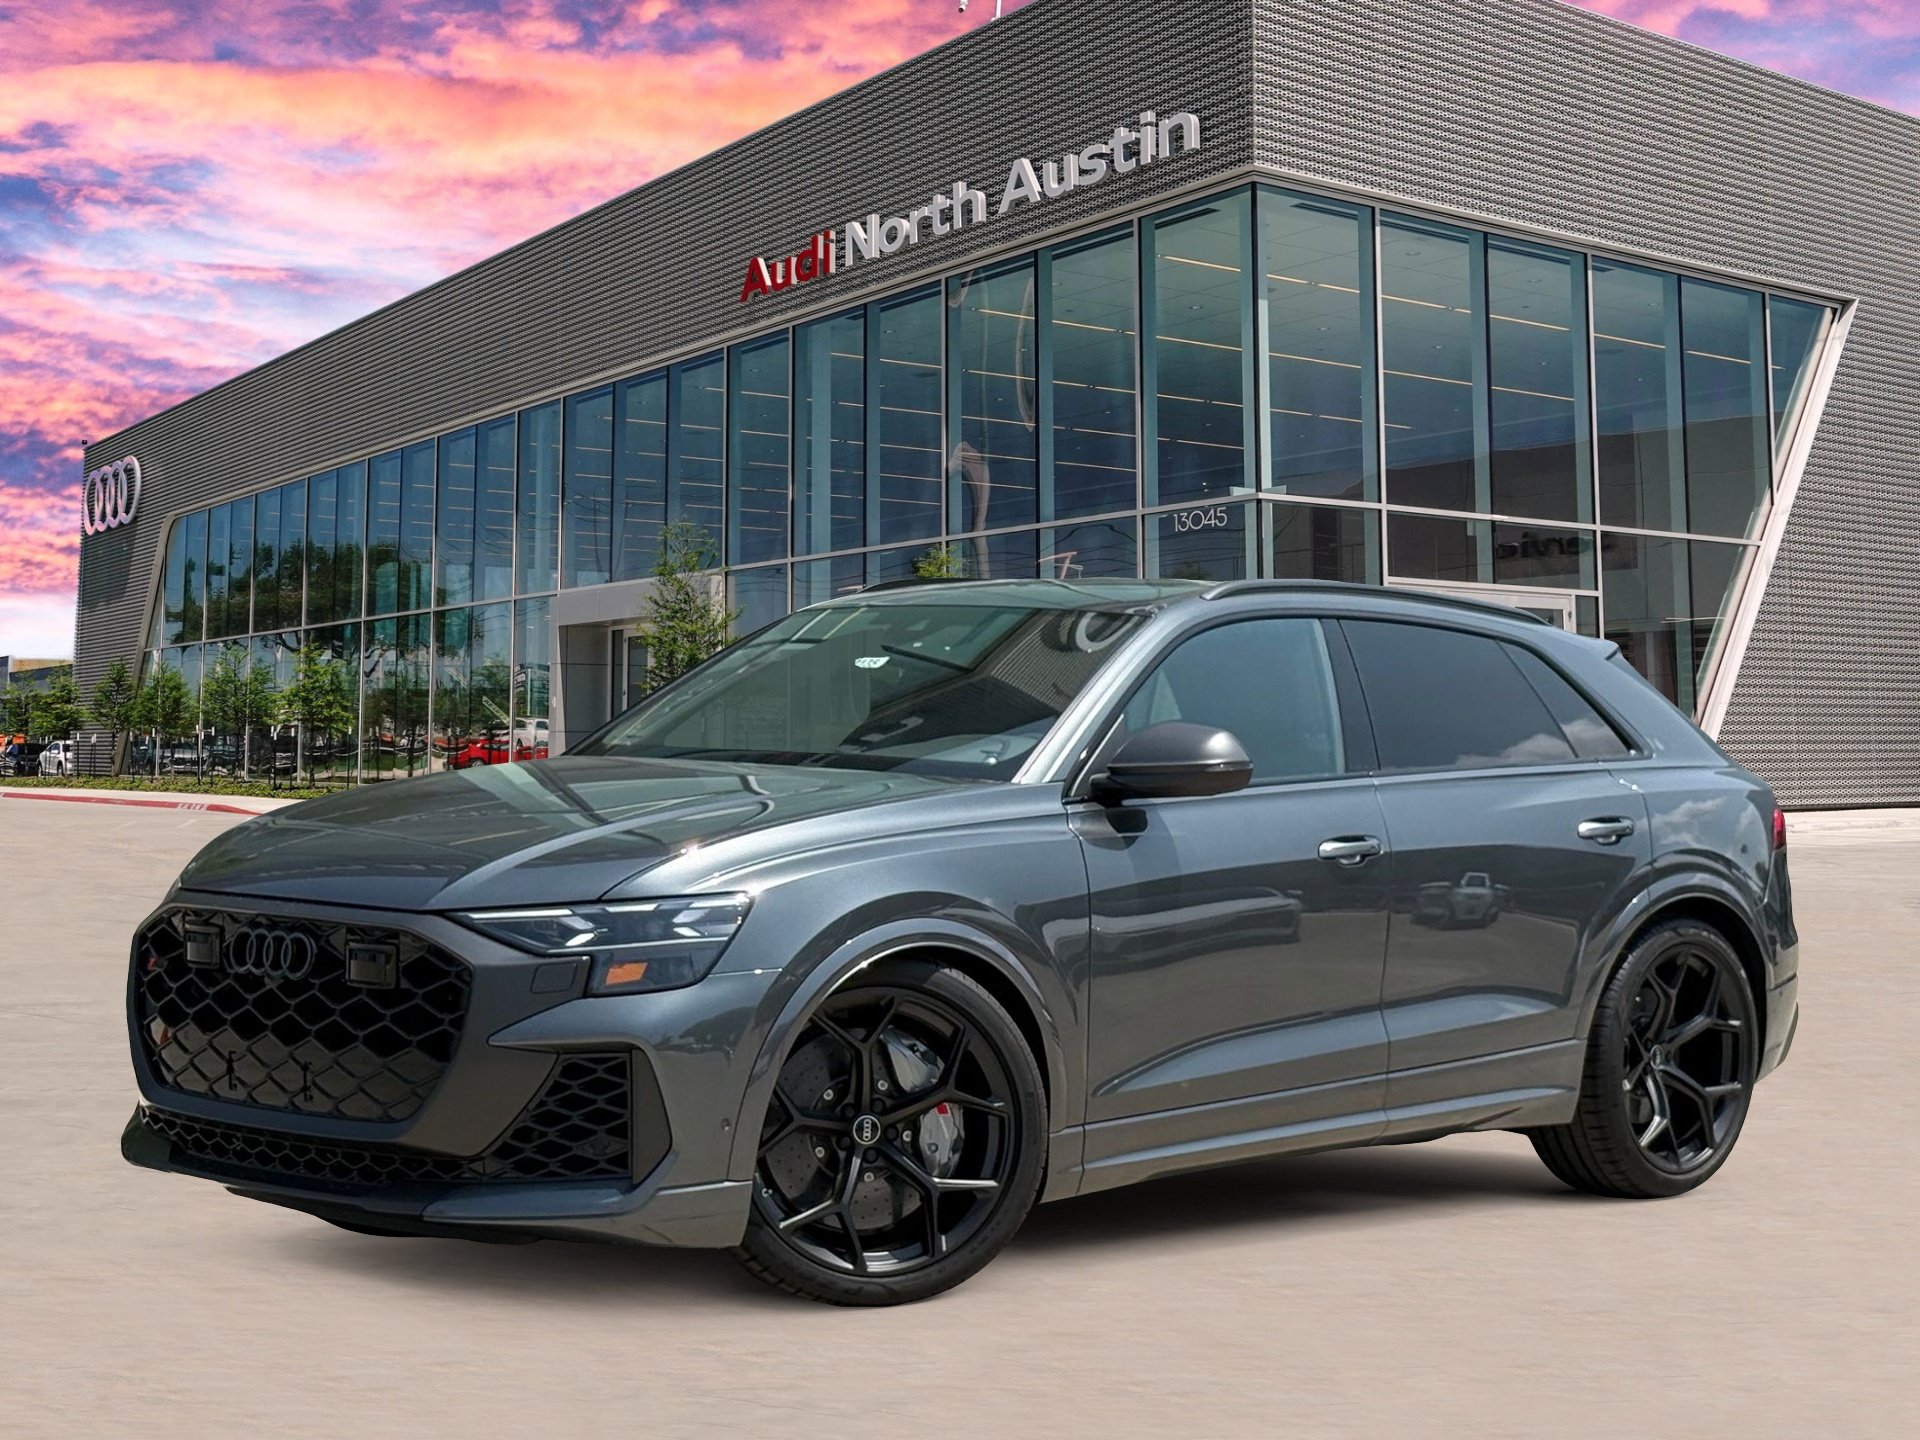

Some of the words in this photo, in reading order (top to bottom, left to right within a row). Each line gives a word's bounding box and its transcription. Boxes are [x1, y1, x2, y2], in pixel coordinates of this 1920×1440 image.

[740, 230, 837, 301] Audi
[844, 181, 987, 266] North
[998, 110, 1201, 213] Austin
[1173, 507, 1228, 532] 13045
